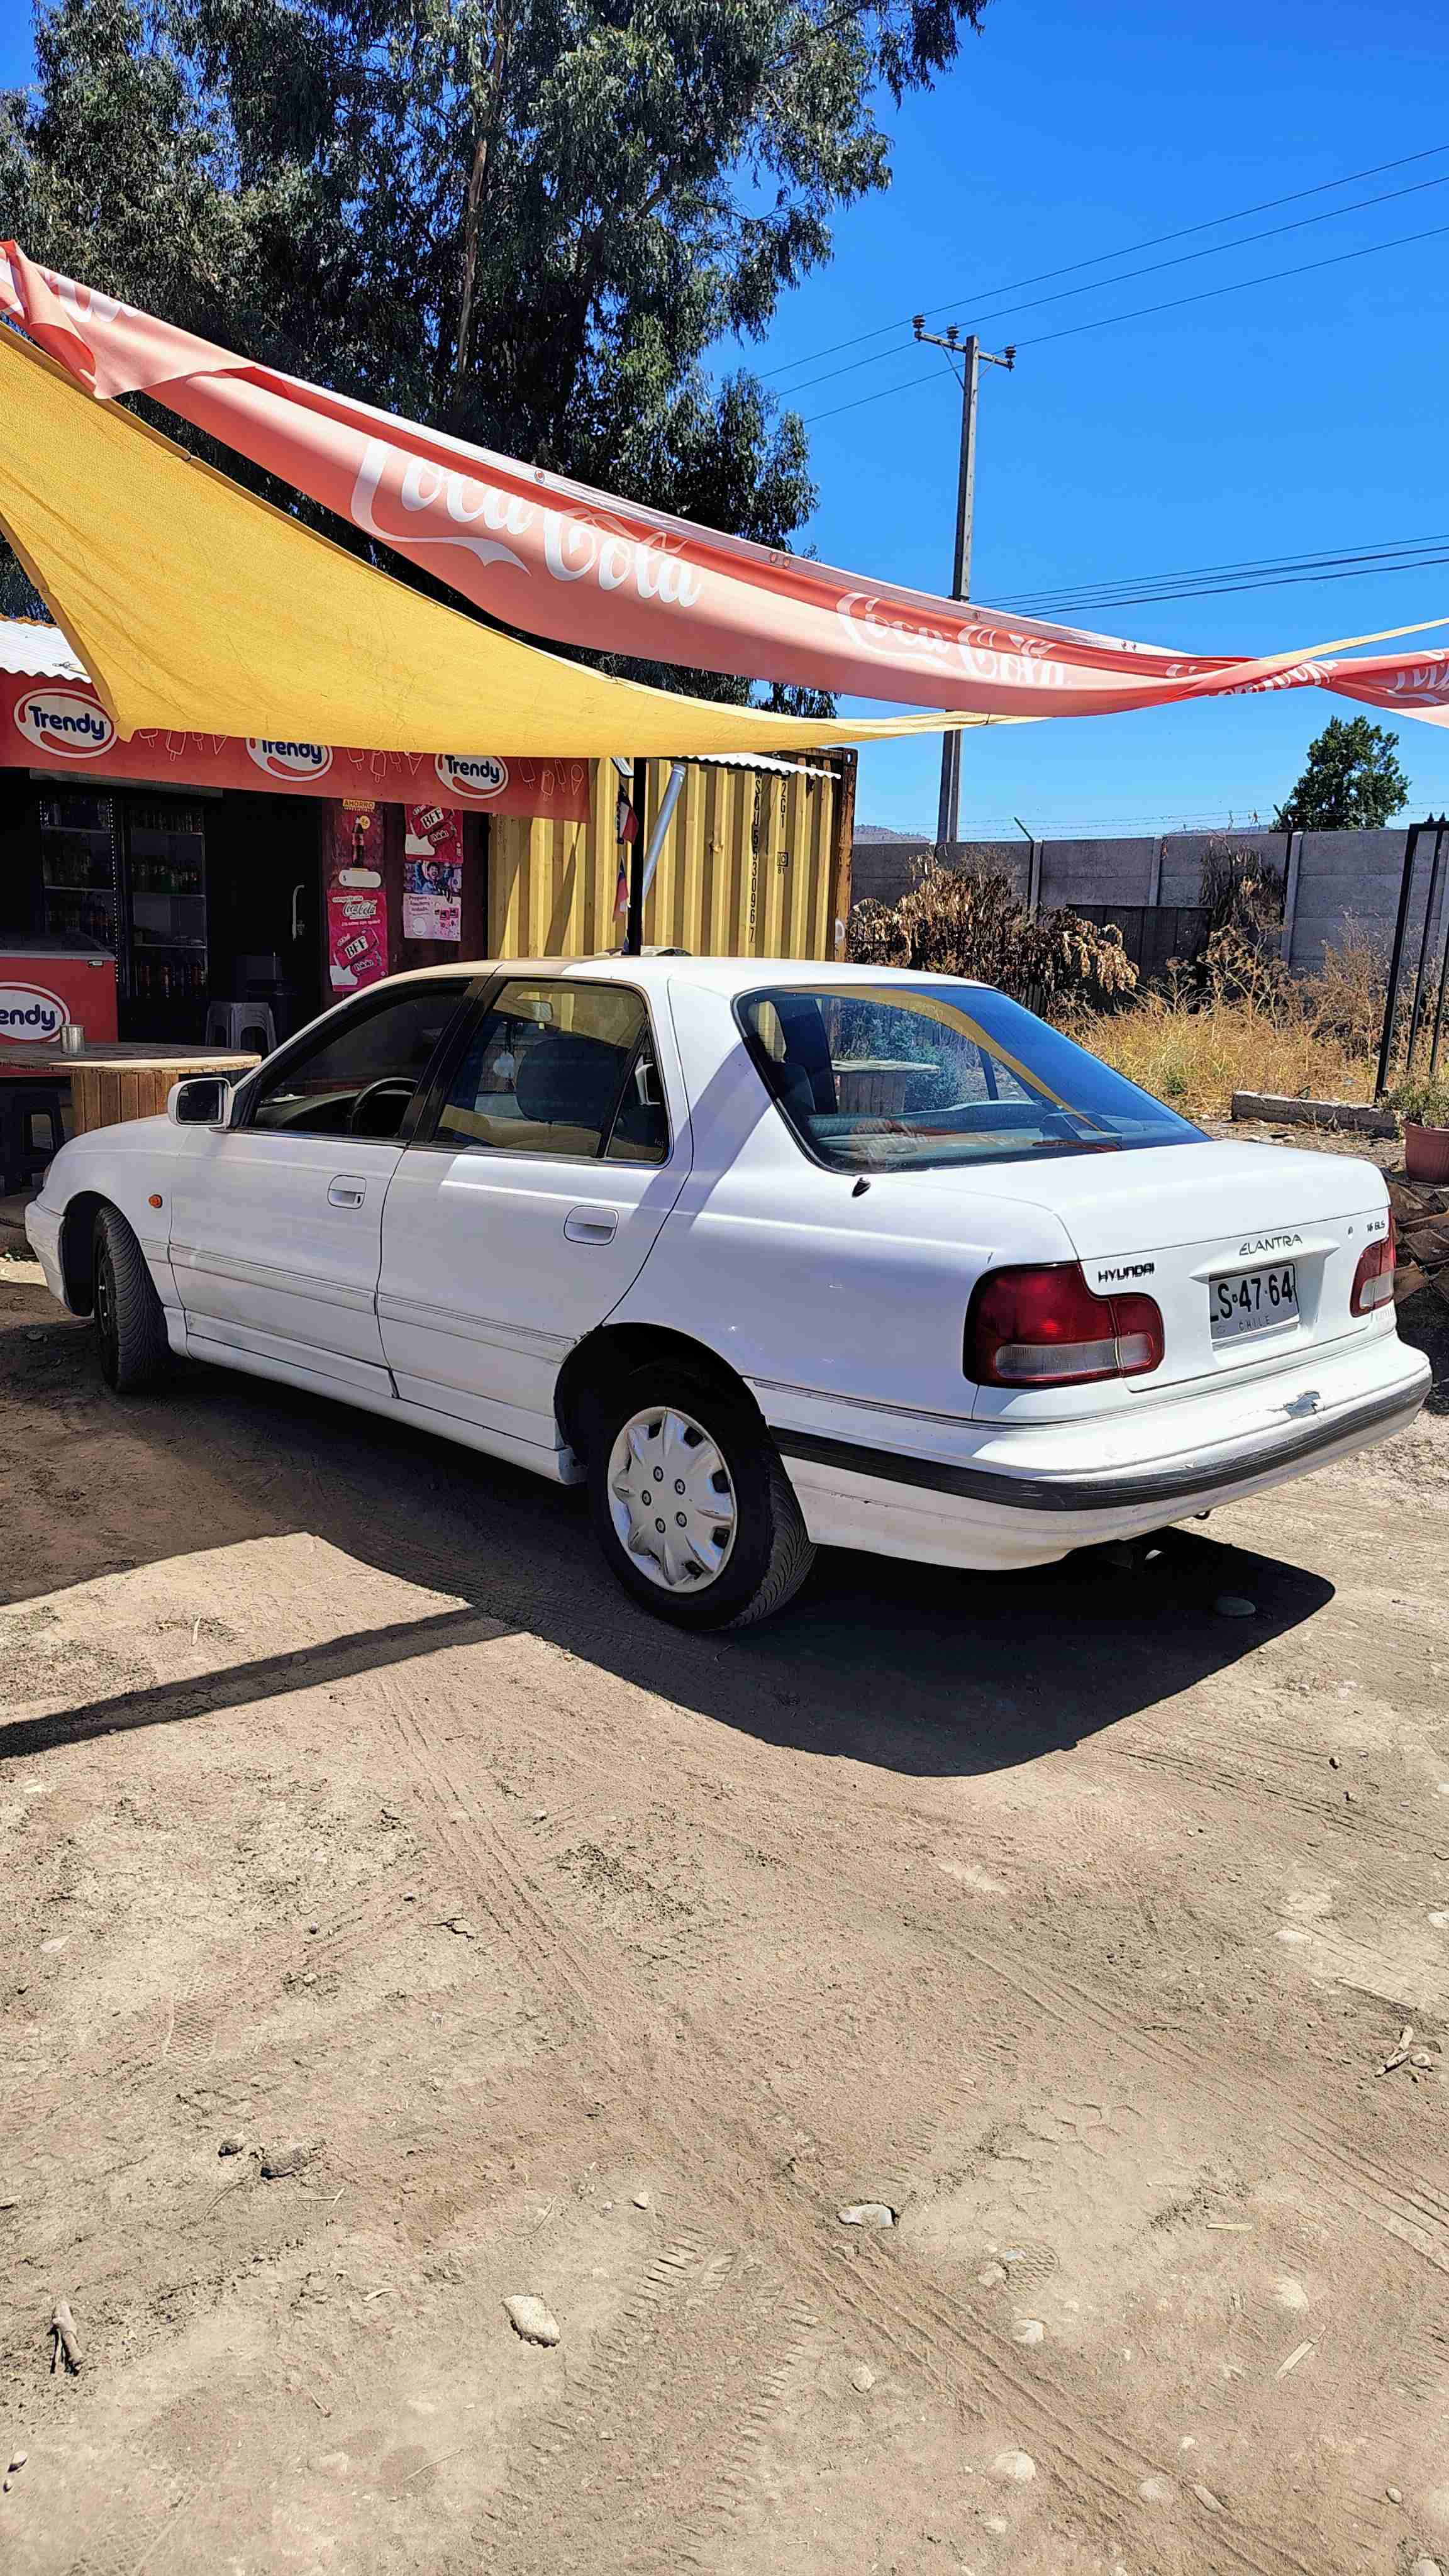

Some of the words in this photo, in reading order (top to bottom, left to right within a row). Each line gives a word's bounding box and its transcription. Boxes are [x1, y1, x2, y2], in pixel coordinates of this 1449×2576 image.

[28, 705, 104, 740] Trendy
[445, 755, 500, 784] Trendy
[344, 799, 374, 808] AHORRO
[422, 808, 441, 828] BFF
[347, 936, 365, 957] BFF
[1239, 1234, 1302, 1255] ELANTRA
[1098, 1262, 1154, 1283] HYUNDAI
[1238, 1316, 1270, 1331] CHILE
